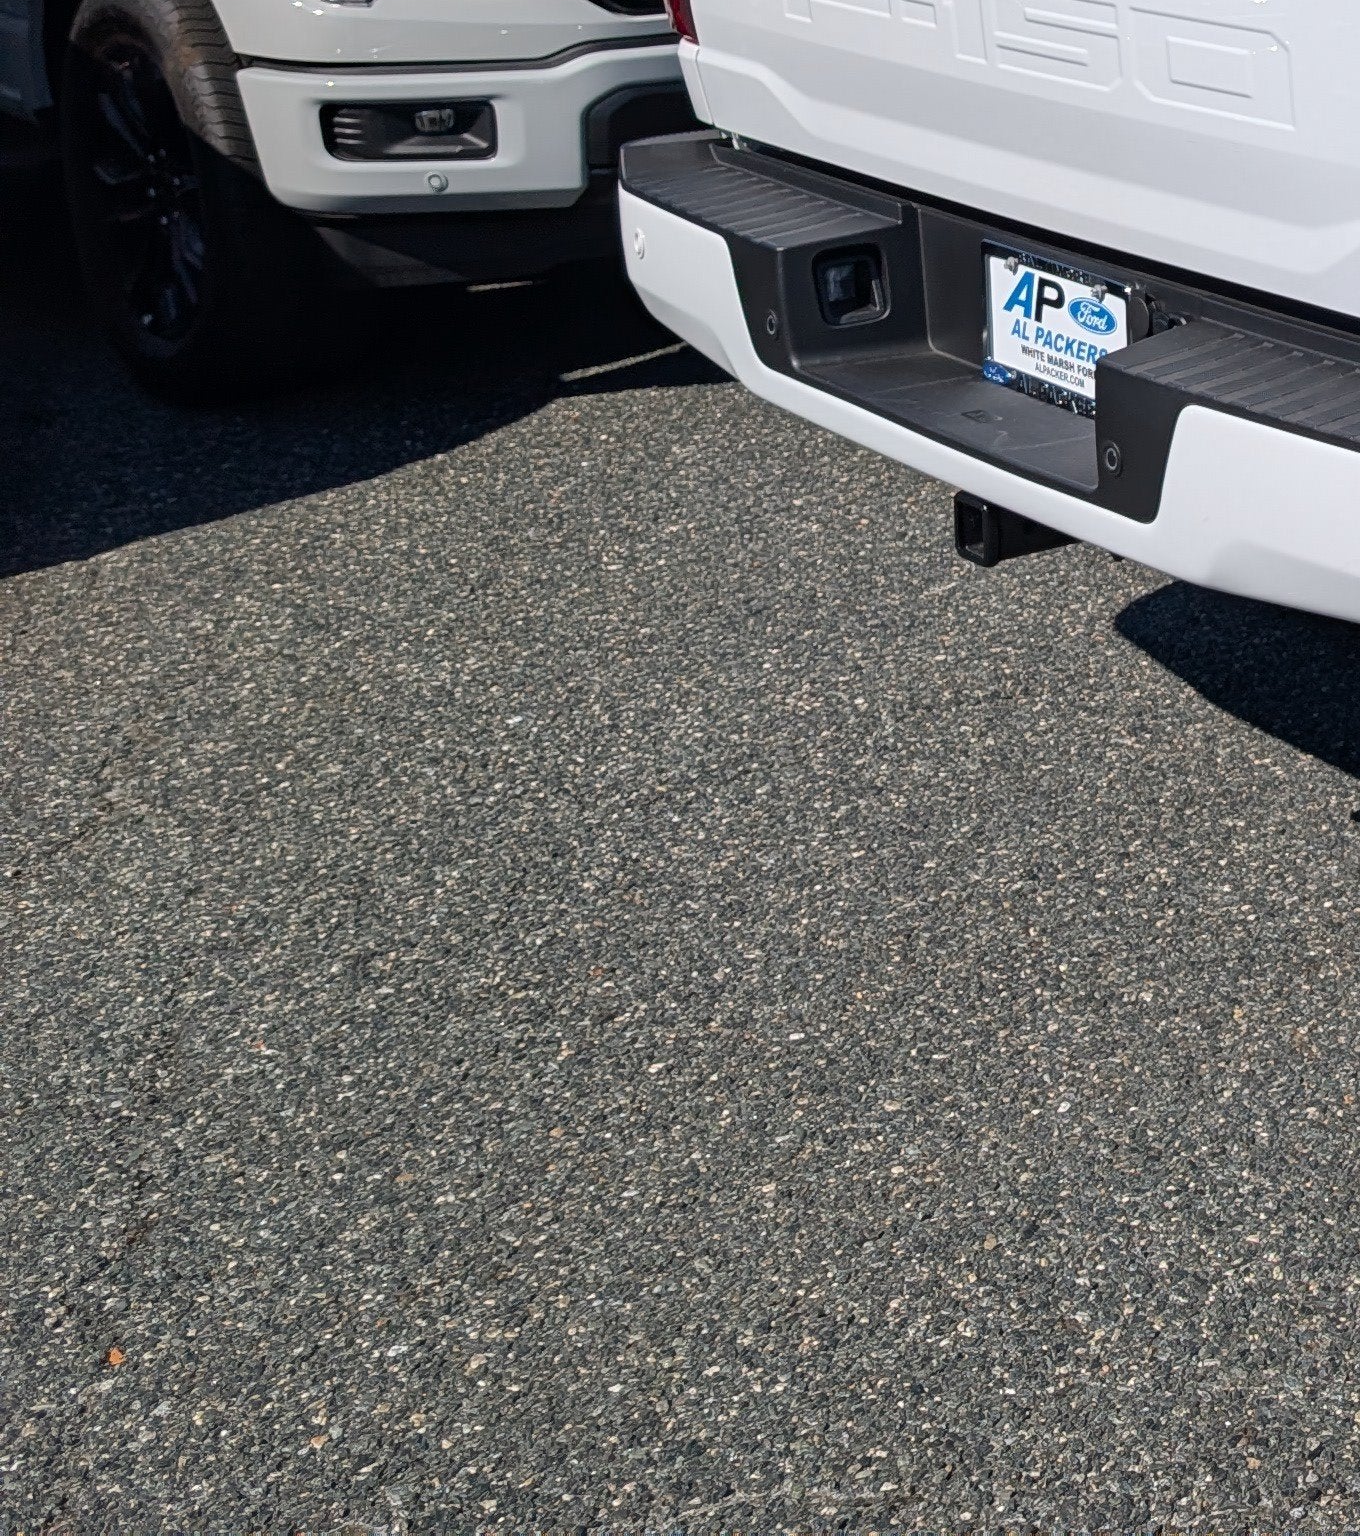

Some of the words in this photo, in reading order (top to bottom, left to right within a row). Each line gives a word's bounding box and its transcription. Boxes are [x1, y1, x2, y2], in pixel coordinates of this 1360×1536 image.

[1003, 271, 1066, 324] AP
[1011, 317, 1030, 341] AL
[1077, 301, 1109, 332] Ford
[1020, 343, 1046, 362] WHITE
[1047, 353, 1076, 374] MARSH
[1034, 362, 1086, 388] ALPACKER.COM
